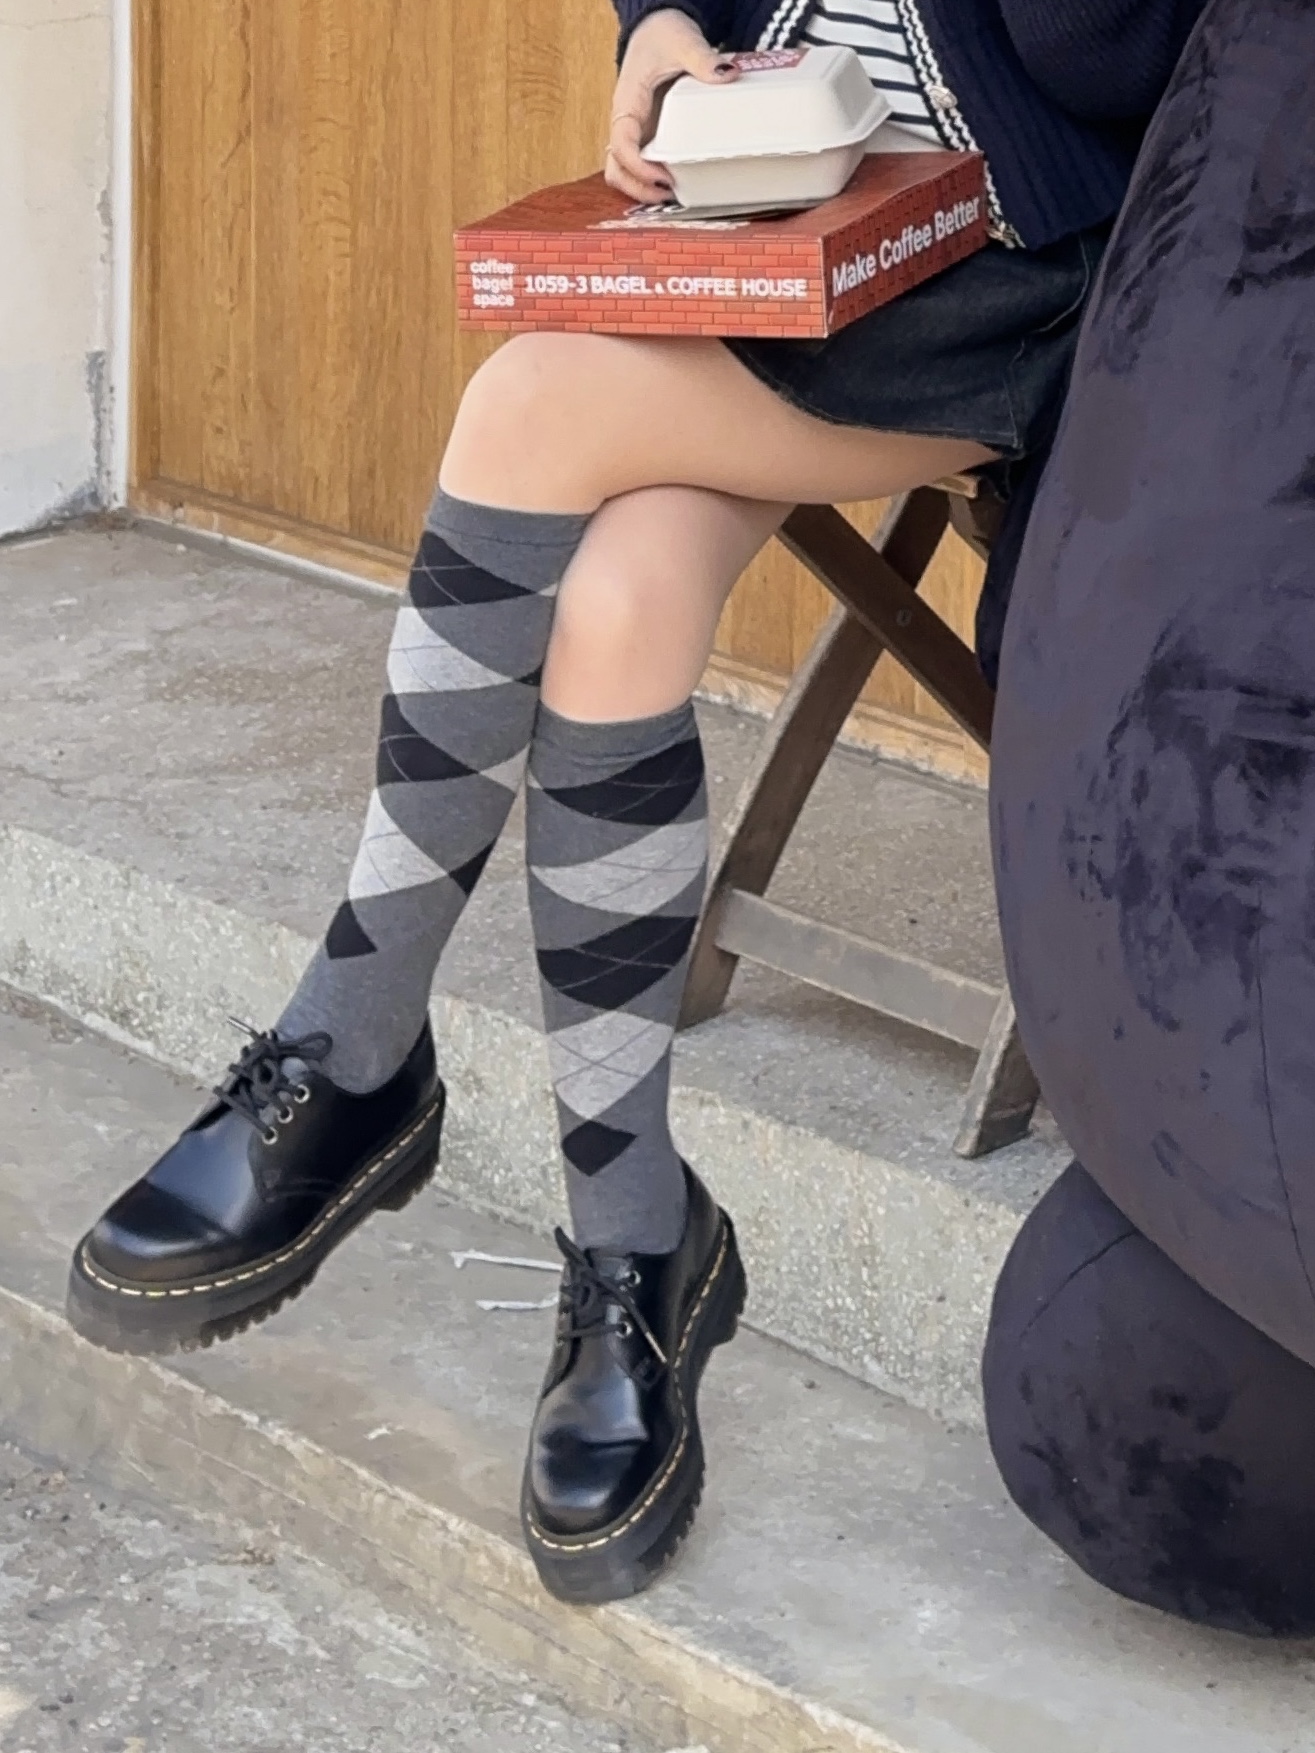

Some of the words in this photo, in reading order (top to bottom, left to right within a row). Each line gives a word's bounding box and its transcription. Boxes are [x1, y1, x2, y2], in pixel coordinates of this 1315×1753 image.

[832, 253, 877, 297] Make
[879, 225, 933, 270] Coffee
[934, 198, 979, 241] Better
[472, 276, 513, 293] bagel
[525, 275, 588, 294] 1059-3
[590, 276, 653, 294] BAGEL
[667, 277, 738, 296] COFFEE
[741, 278, 807, 297] HOUSE
